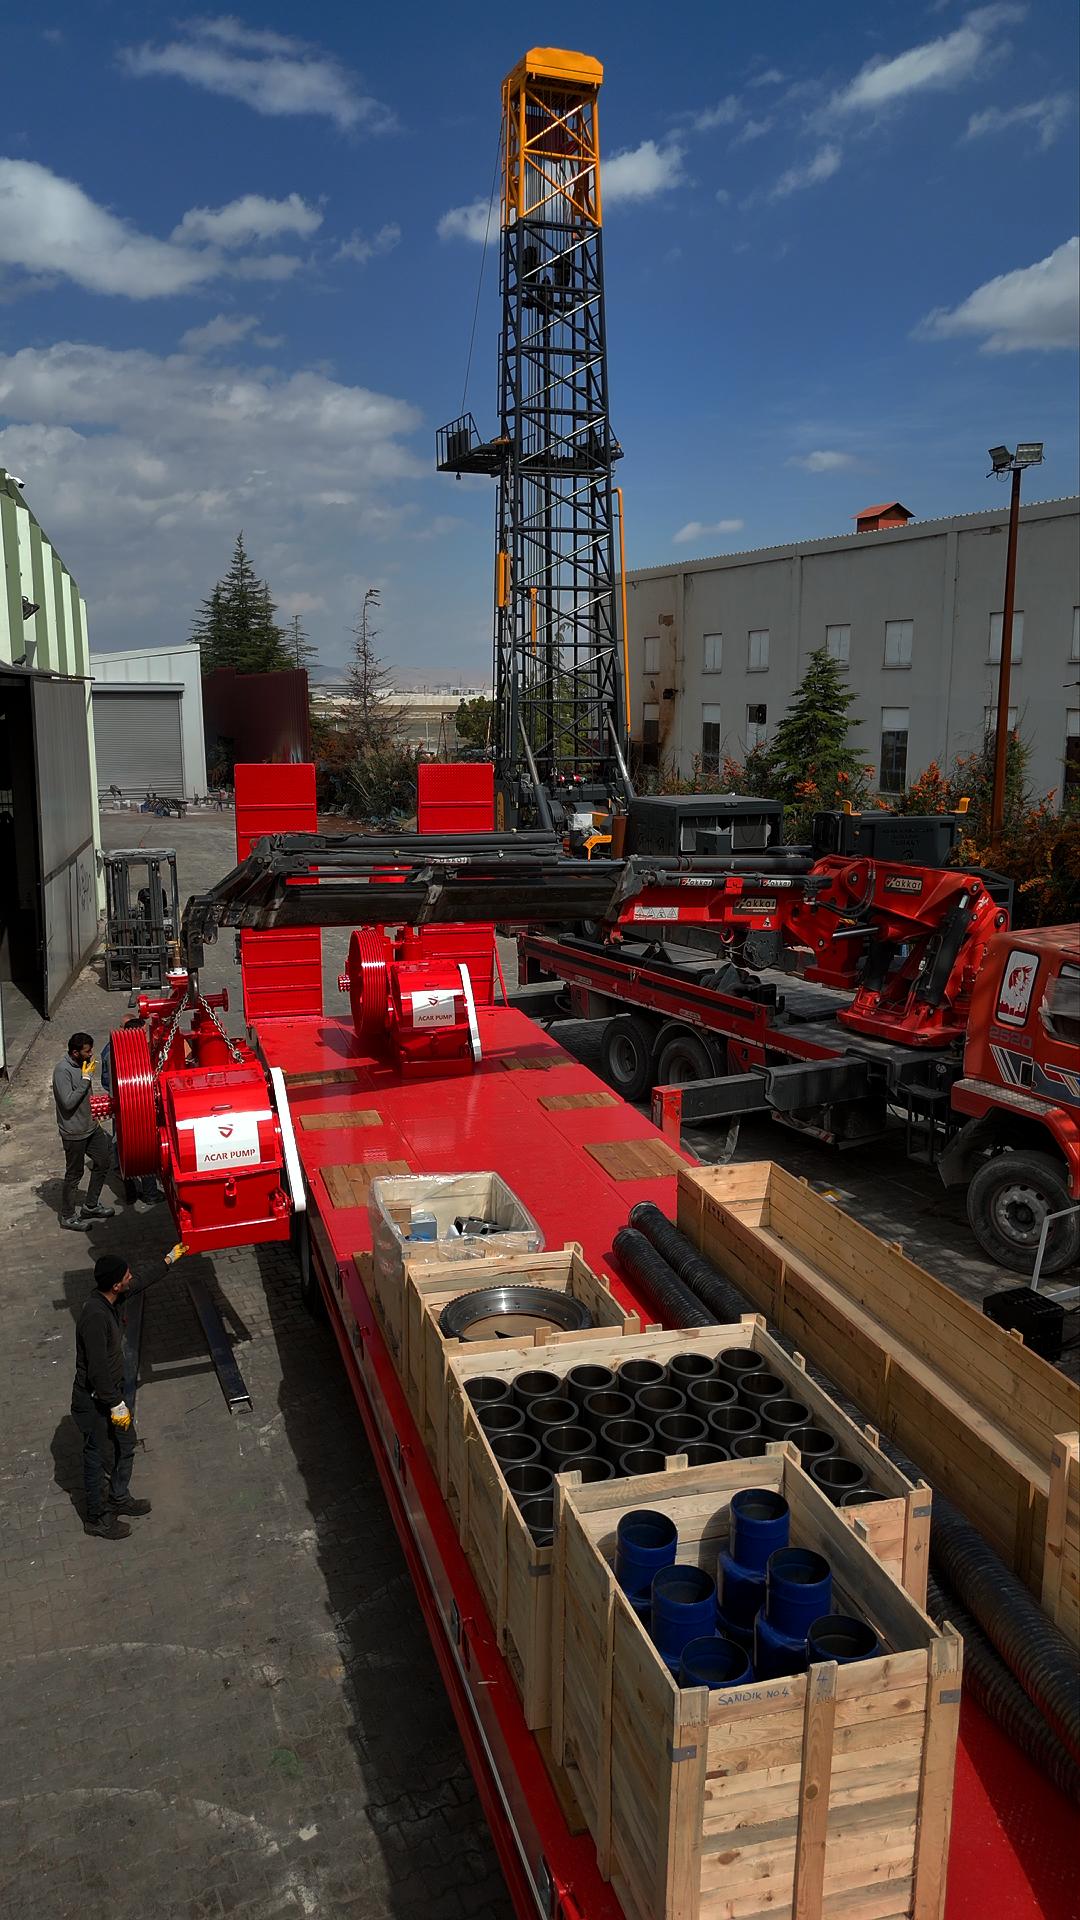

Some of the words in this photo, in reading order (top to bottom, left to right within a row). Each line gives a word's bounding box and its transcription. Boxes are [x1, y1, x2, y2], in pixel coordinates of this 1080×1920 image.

[204, 1152, 228, 1162] ACAR
[230, 1148, 256, 1158] PUMP
[816, 1671, 828, 1685] 4
[717, 1690, 762, 1706] SANDIK
[781, 1687, 790, 1698] 4
